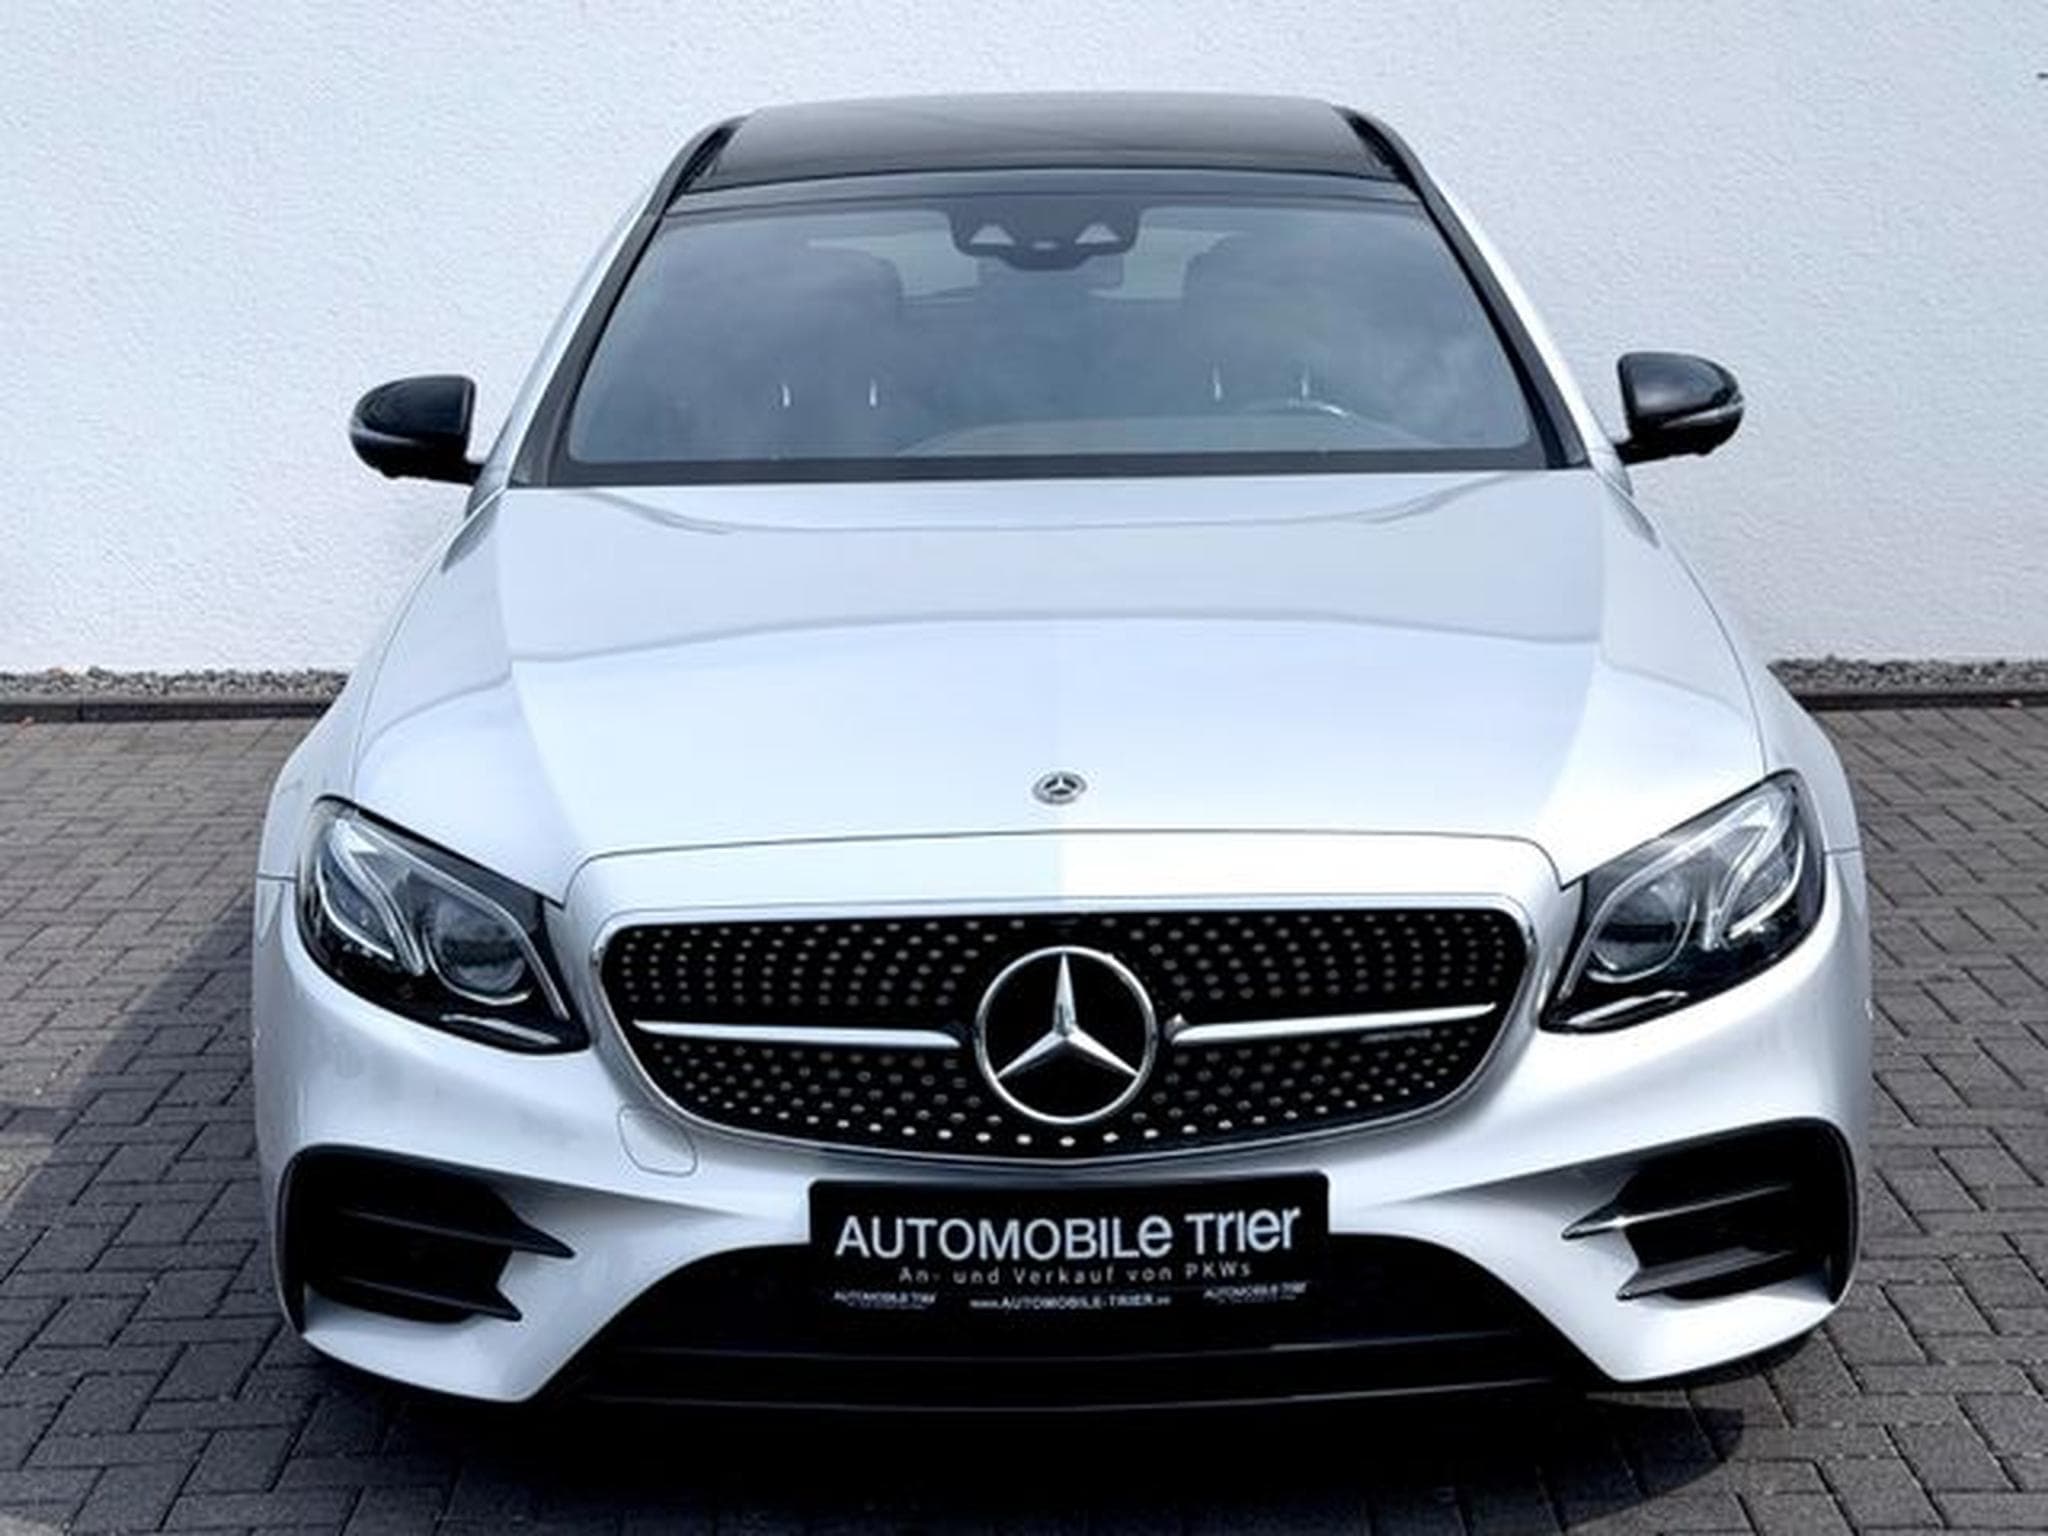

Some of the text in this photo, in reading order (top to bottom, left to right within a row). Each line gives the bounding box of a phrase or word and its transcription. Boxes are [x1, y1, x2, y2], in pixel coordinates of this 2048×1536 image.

[952, 1267, 1000, 1285] und
[1013, 1265, 1114, 1285] Verkauf
[1126, 1266, 1172, 1283] von
